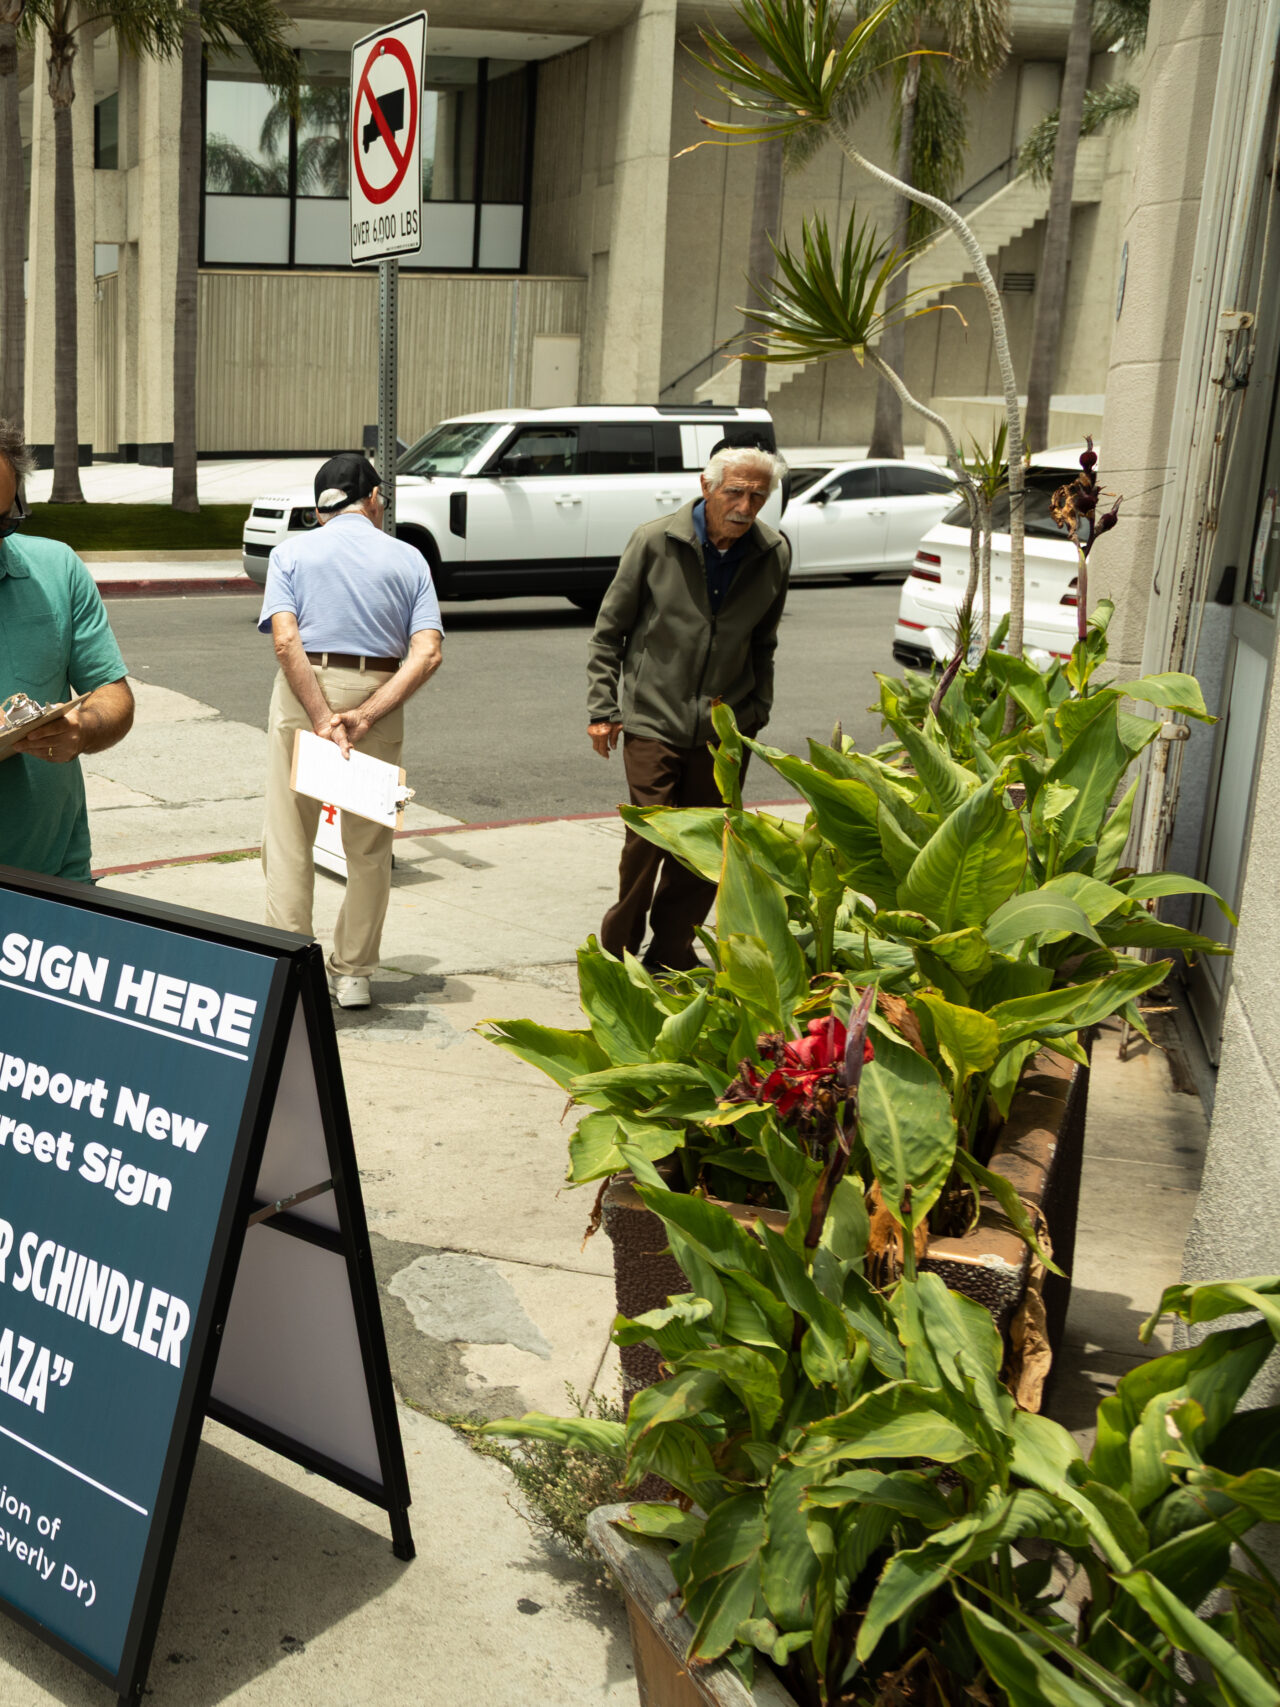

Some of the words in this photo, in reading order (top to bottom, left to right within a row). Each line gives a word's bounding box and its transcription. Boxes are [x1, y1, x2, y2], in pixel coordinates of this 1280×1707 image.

[353, 220, 370, 247] OVER
[401, 209, 418, 236] LBS
[114, 963, 257, 1047] HERE
[113, 1086, 209, 1153] New
[78, 1141, 173, 1212] Sign
[12, 1231, 190, 1369] SCHINDLER
[37, 1515, 61, 1540] of
[60, 1564, 97, 1608] Dr)
